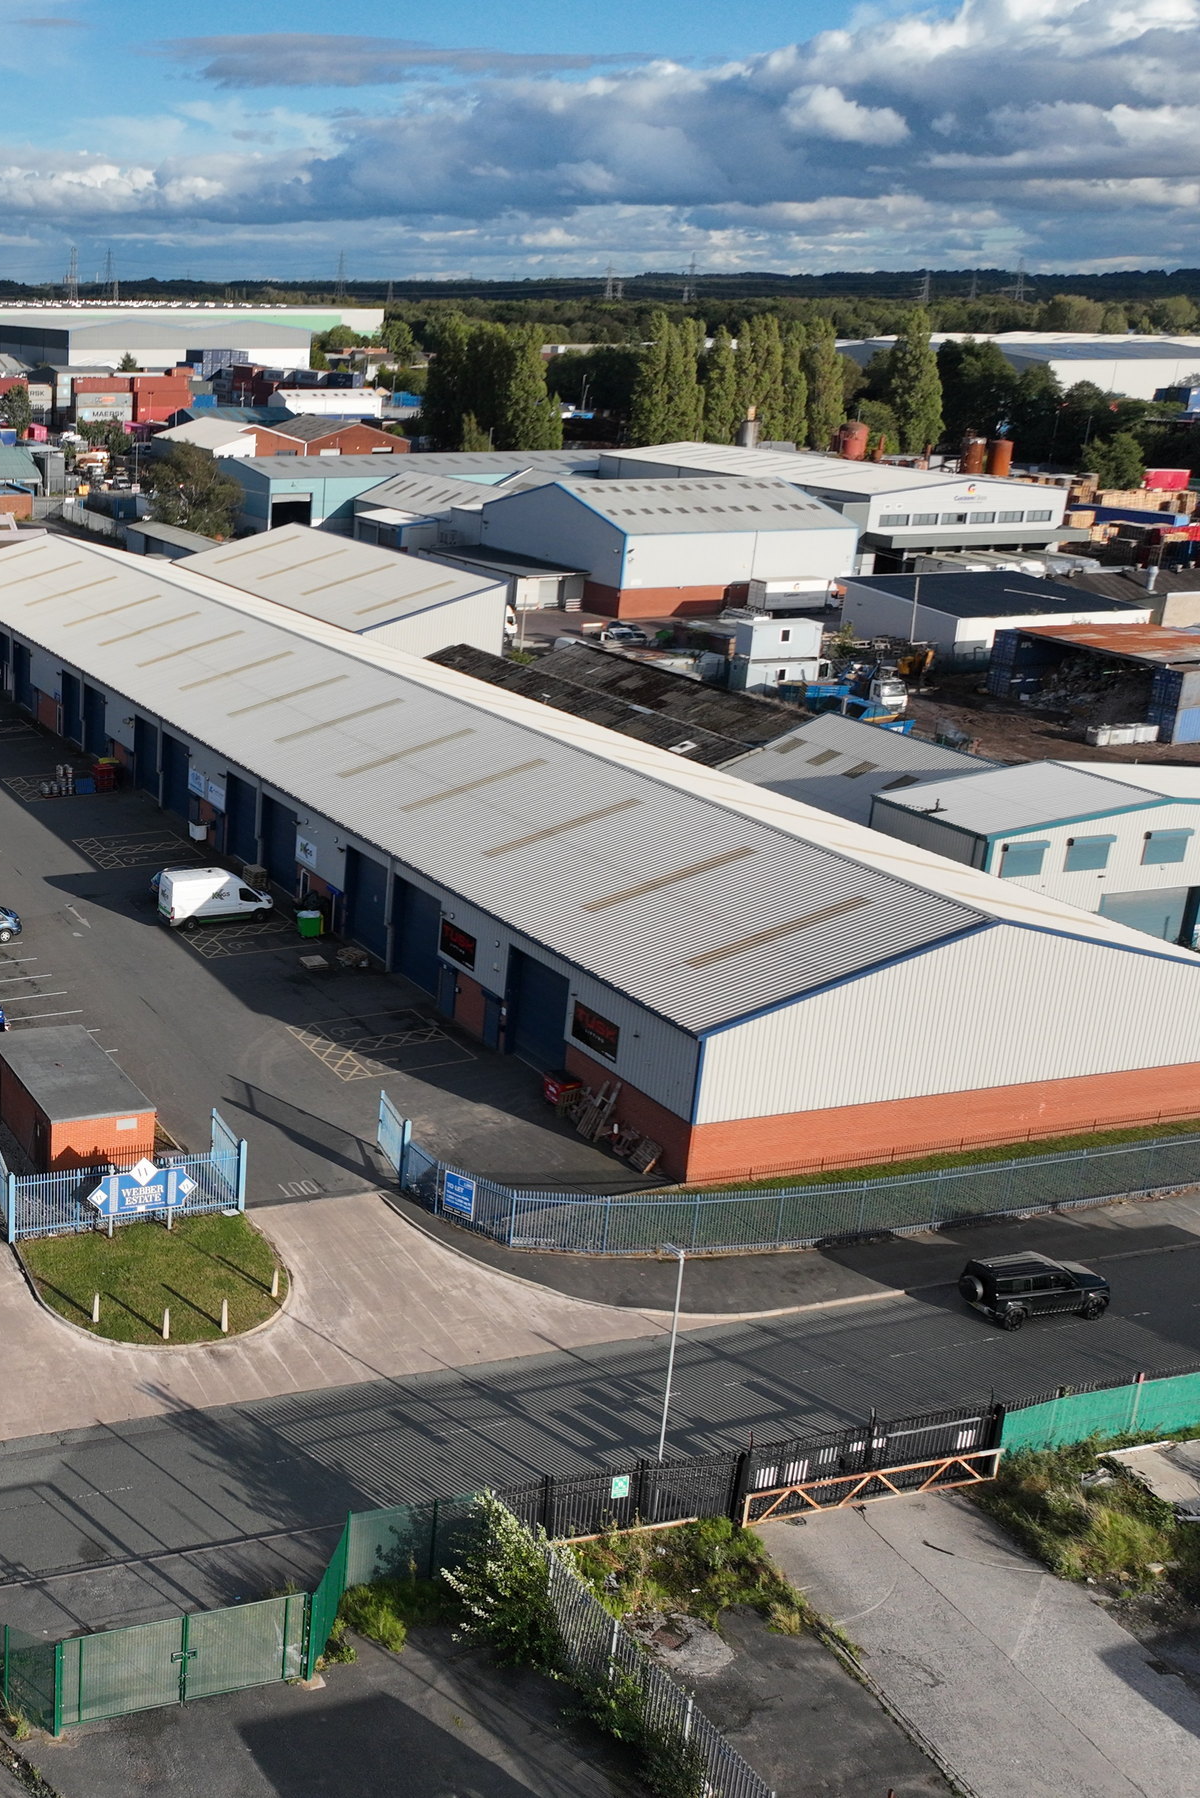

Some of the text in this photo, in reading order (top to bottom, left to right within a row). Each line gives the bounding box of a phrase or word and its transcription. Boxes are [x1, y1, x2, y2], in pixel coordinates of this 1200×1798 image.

[92, 410, 125, 418] MAERSK
[121, 1184, 164, 1198] WEBBER
[277, 1180, 319, 1198] OUT
[125, 1193, 162, 1206] ESTATE
